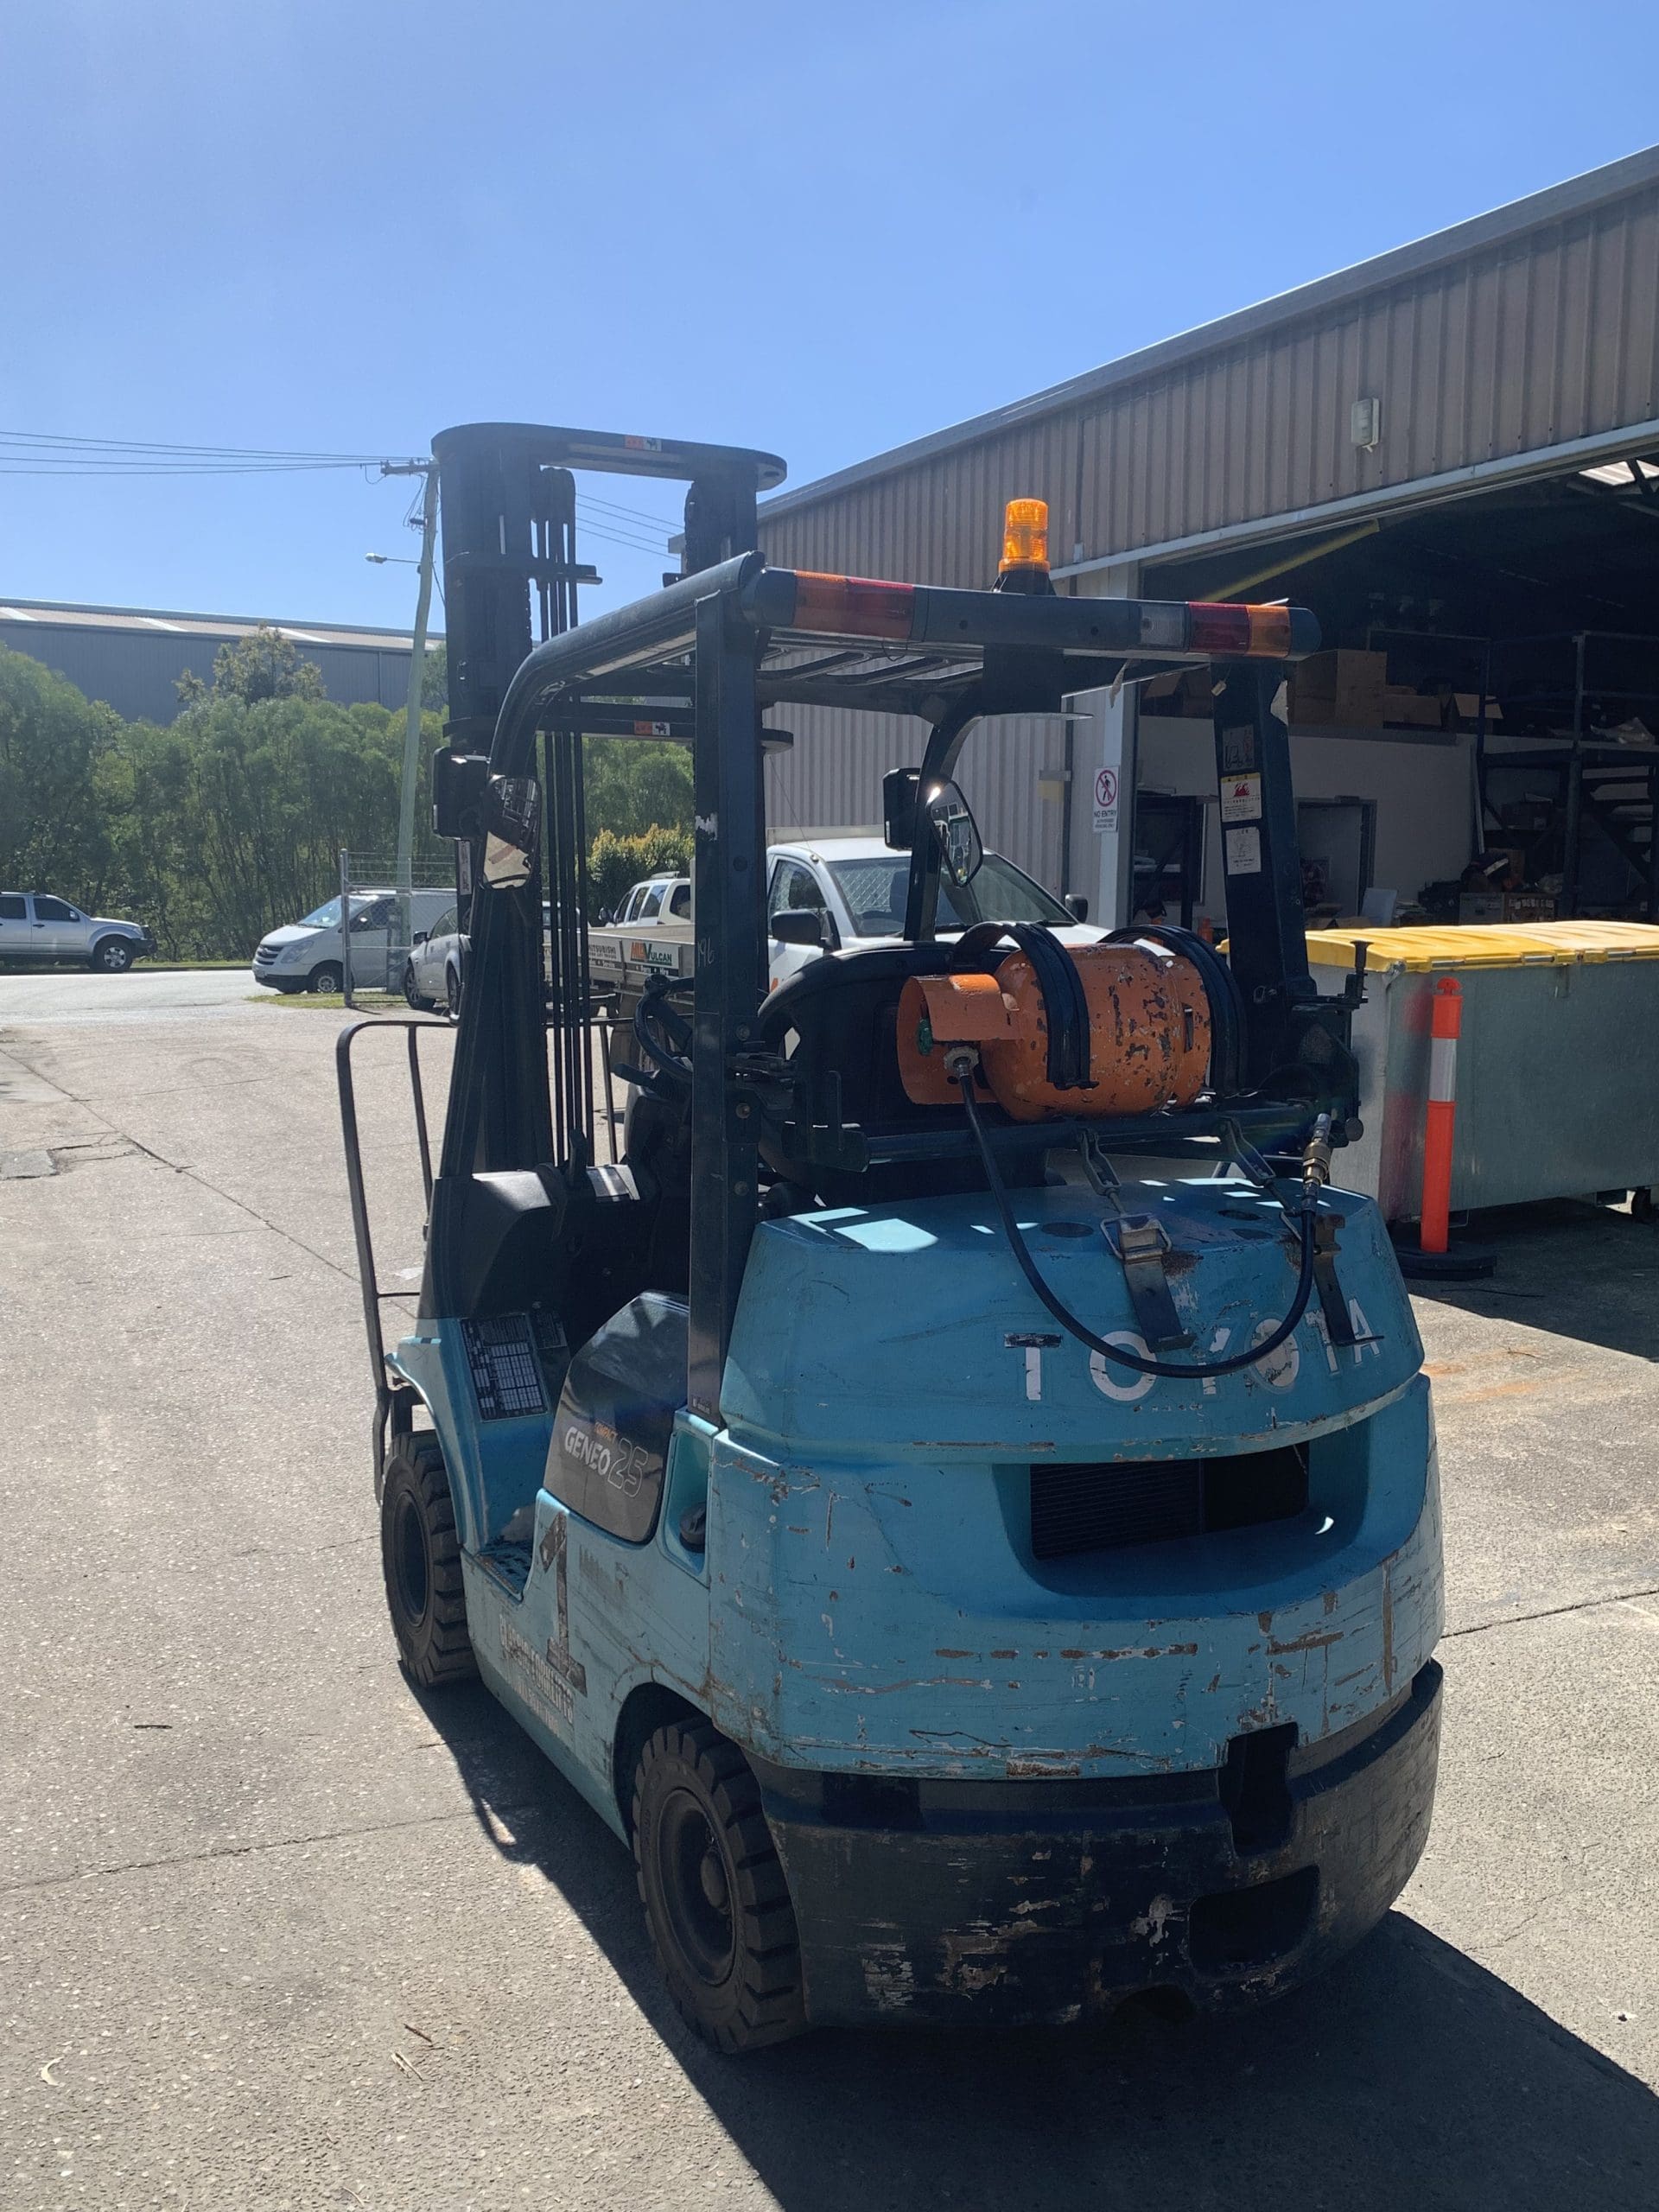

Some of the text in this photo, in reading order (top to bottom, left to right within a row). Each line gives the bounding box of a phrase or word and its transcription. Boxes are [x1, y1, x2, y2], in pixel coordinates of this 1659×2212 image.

[644, 943, 672, 963] VULCAN
[564, 1426, 648, 1497] GENEO 25
